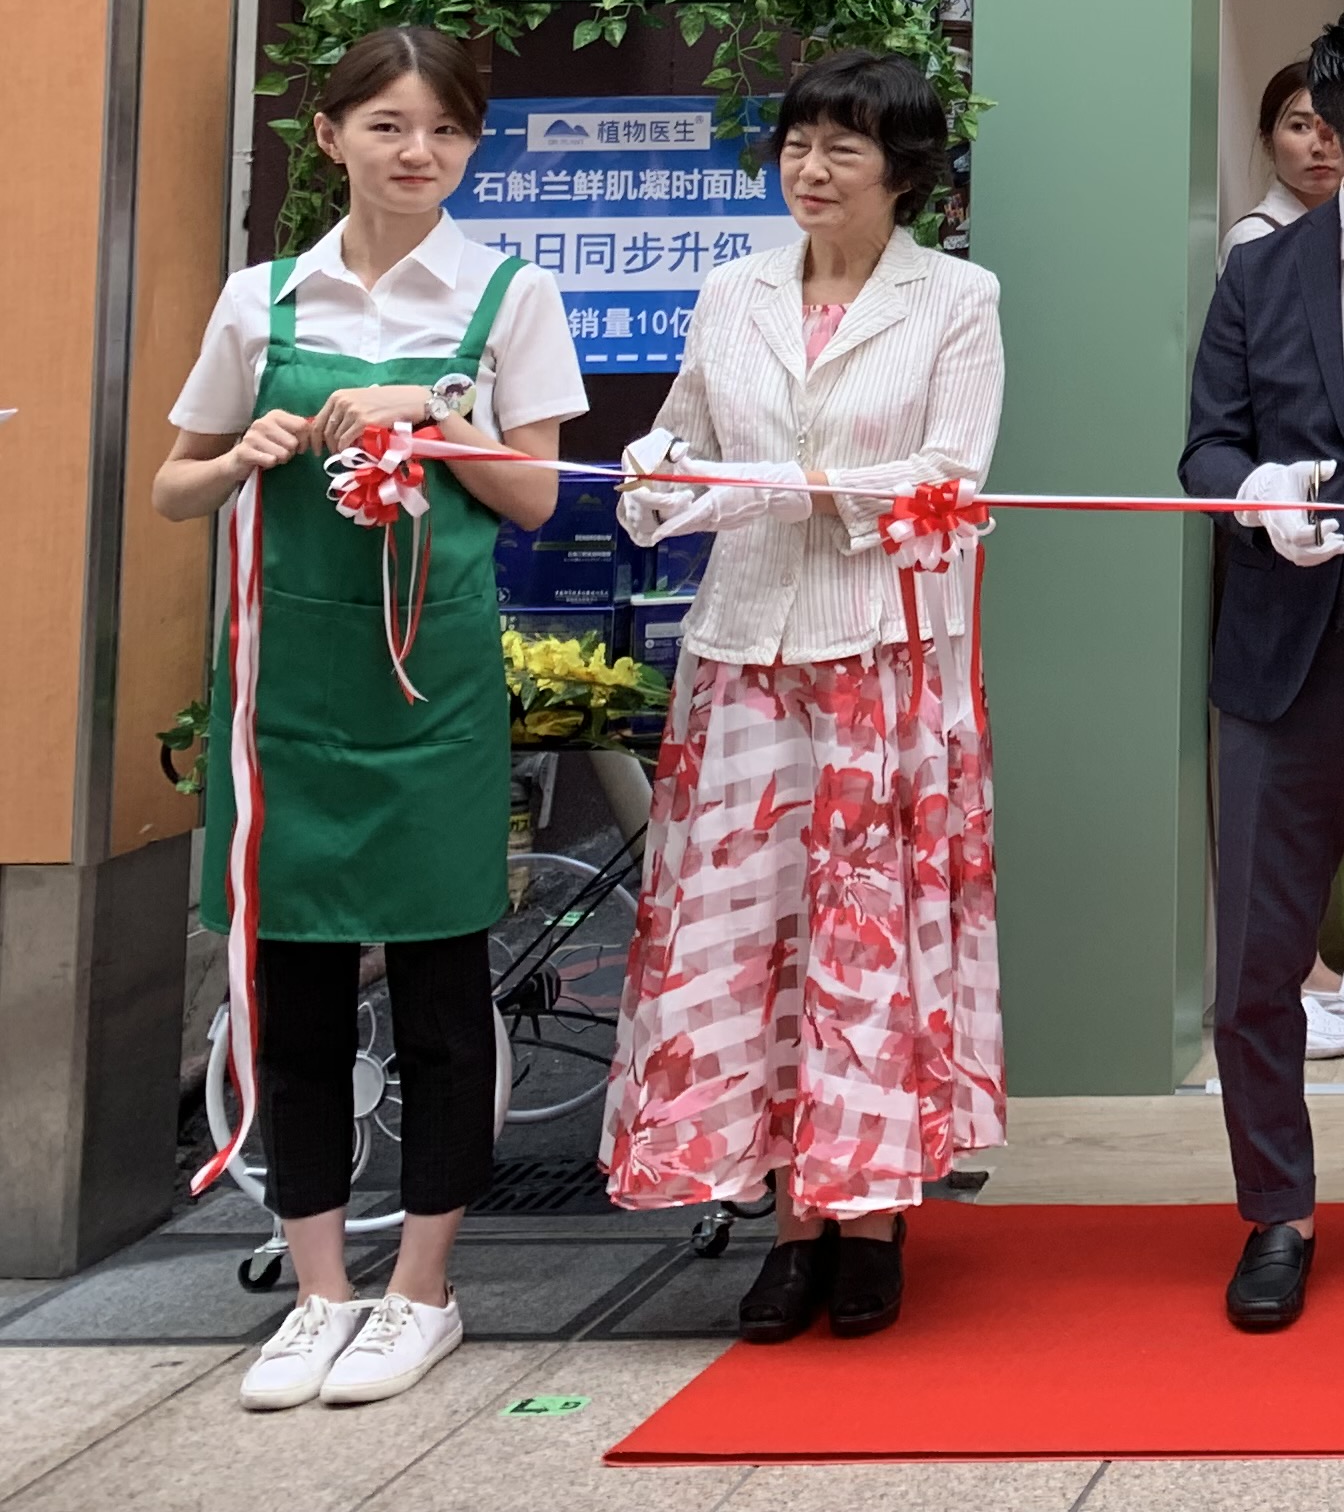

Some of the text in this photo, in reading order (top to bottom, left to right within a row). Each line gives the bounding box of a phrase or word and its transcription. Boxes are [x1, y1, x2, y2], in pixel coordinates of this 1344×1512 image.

[597, 119, 696, 145] 植物医生
[473, 168, 767, 203] 石斛兰鲜肌凝时面膜
